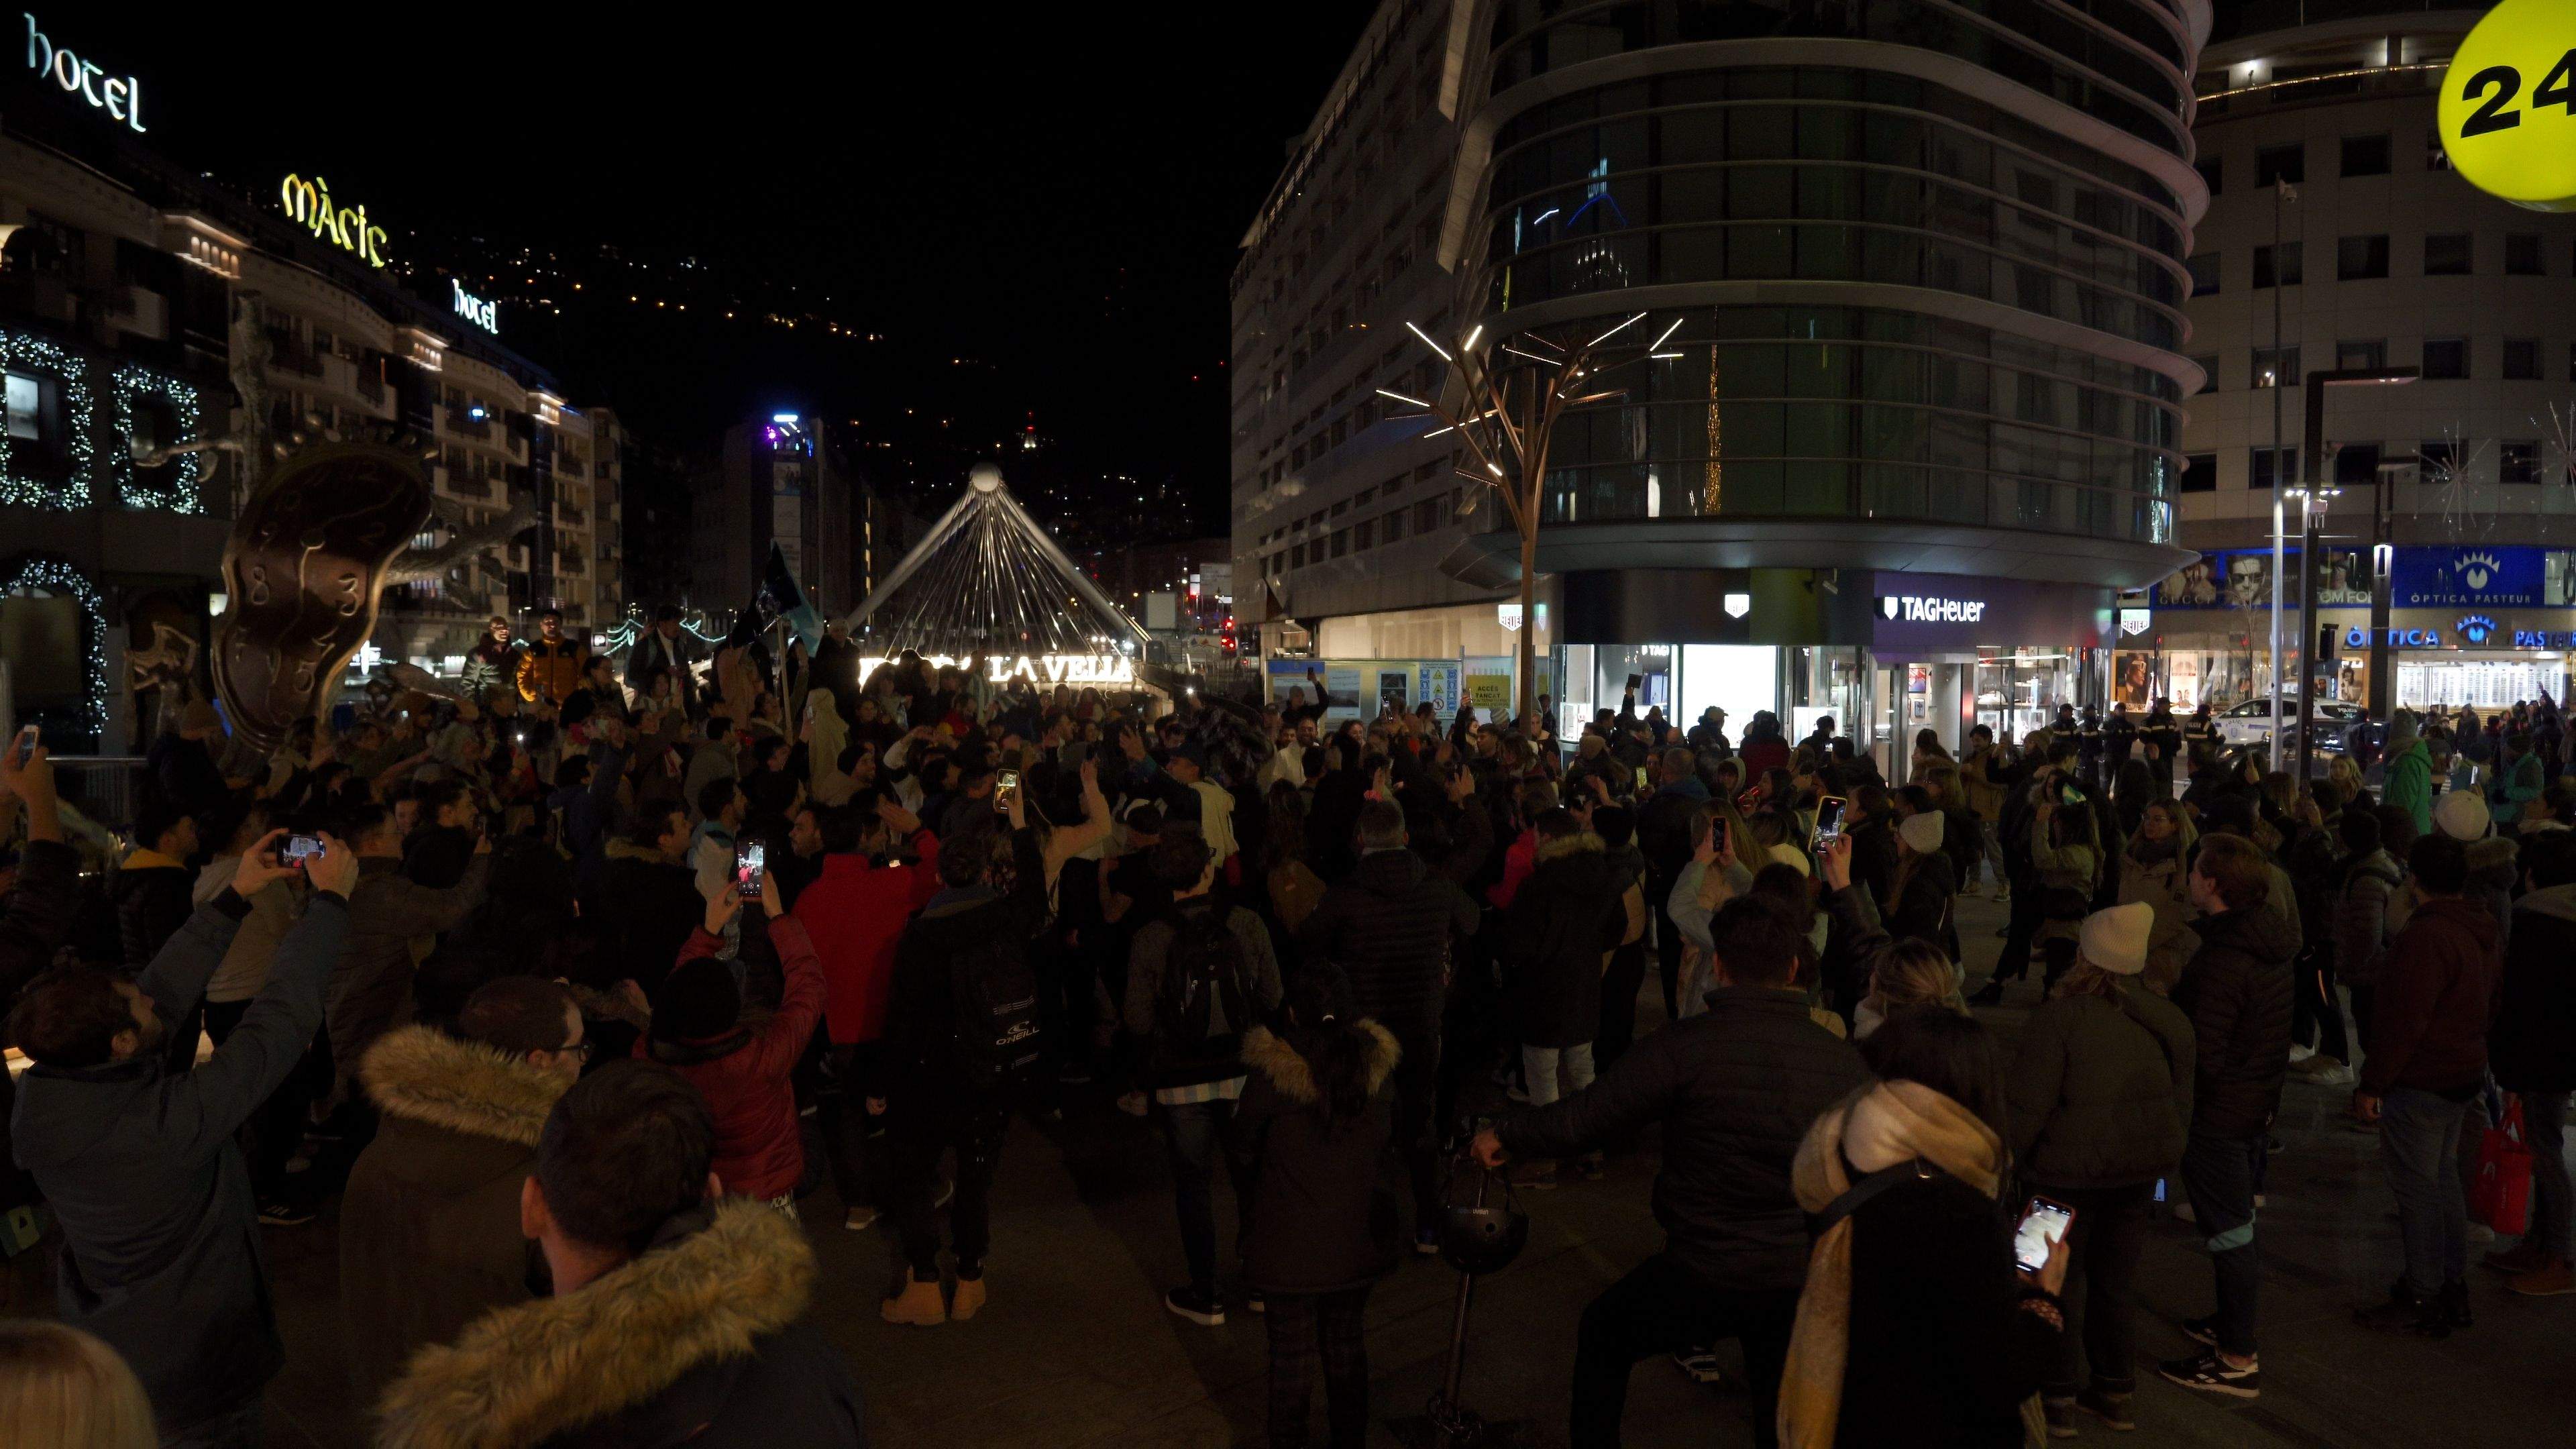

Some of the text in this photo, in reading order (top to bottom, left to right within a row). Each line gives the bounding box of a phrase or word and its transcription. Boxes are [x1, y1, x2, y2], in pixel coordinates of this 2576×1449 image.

[2475, 594, 2530, 603] PASTEUR
[989, 655, 1037, 682] LA
[1041, 655, 1133, 683] VELLA
